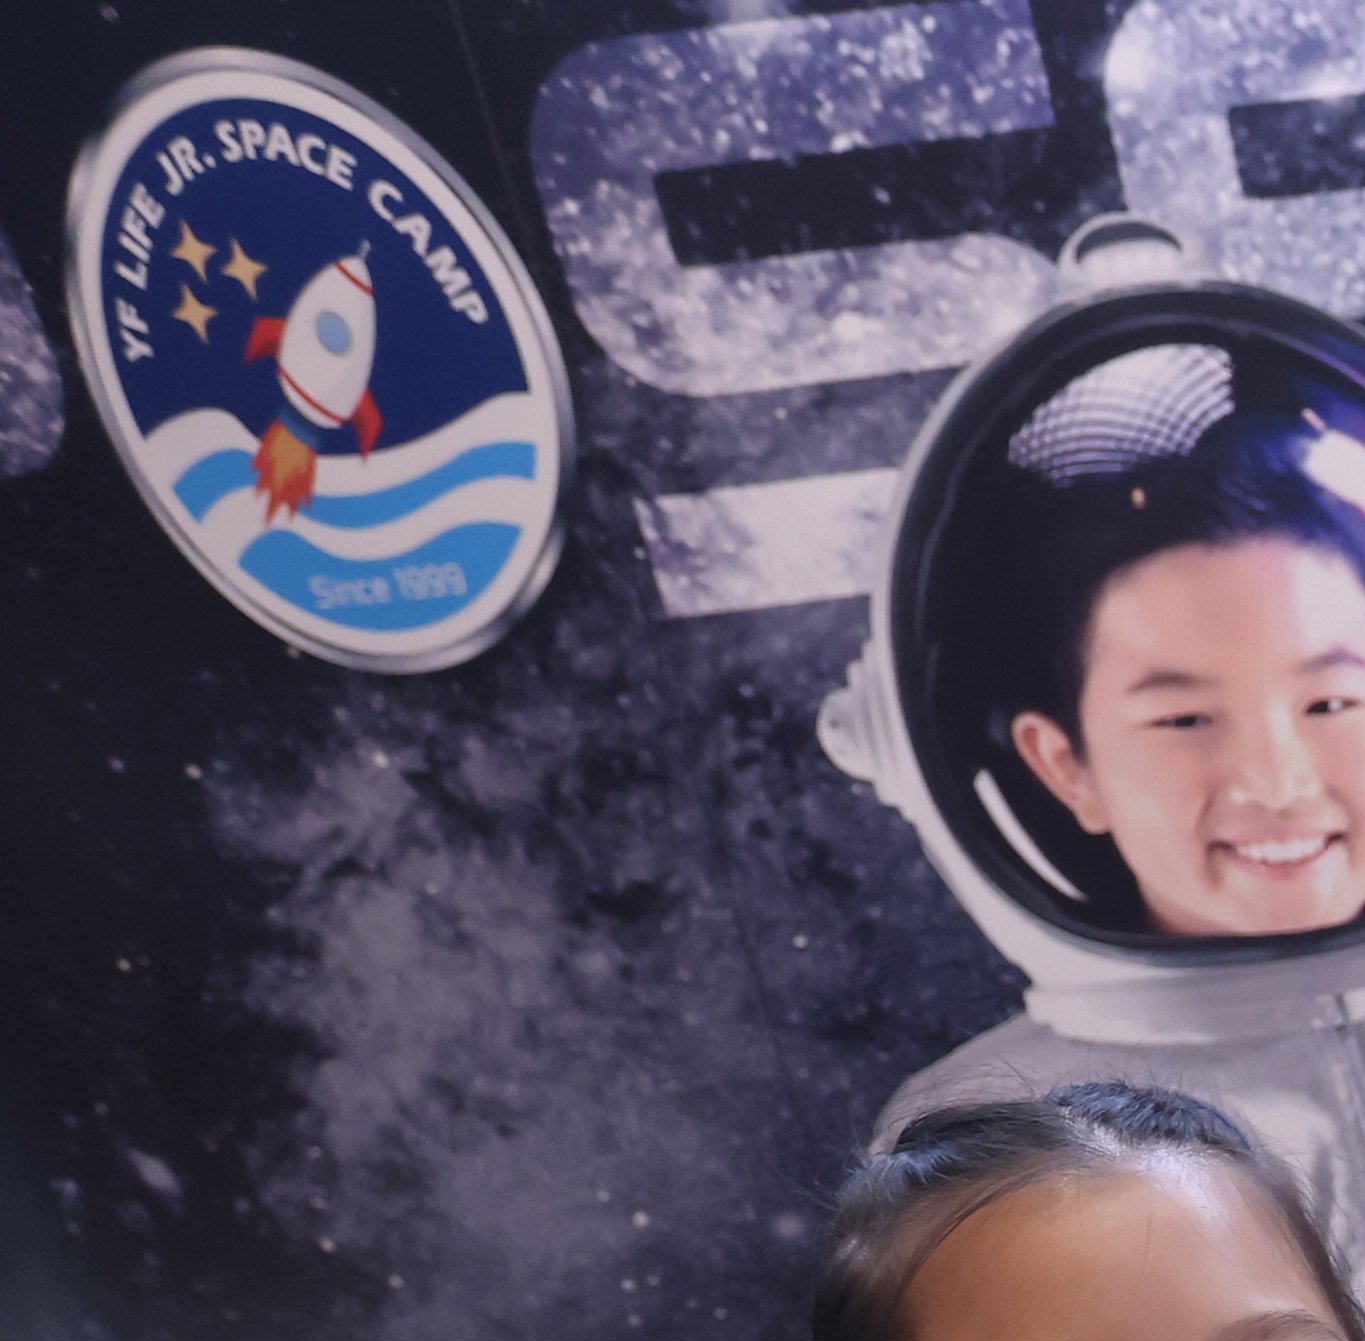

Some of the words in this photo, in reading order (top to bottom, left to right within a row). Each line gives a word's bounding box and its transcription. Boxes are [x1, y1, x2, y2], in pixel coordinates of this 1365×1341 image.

[156, 137, 217, 196] JR.
[215, 120, 358, 190] SPACE
[115, 184, 165, 290] LIFE
[367, 180, 488, 325] CAMP
[117, 298, 154, 363] YF
[310, 572, 389, 608] Since
[395, 562, 466, 597] 1999
